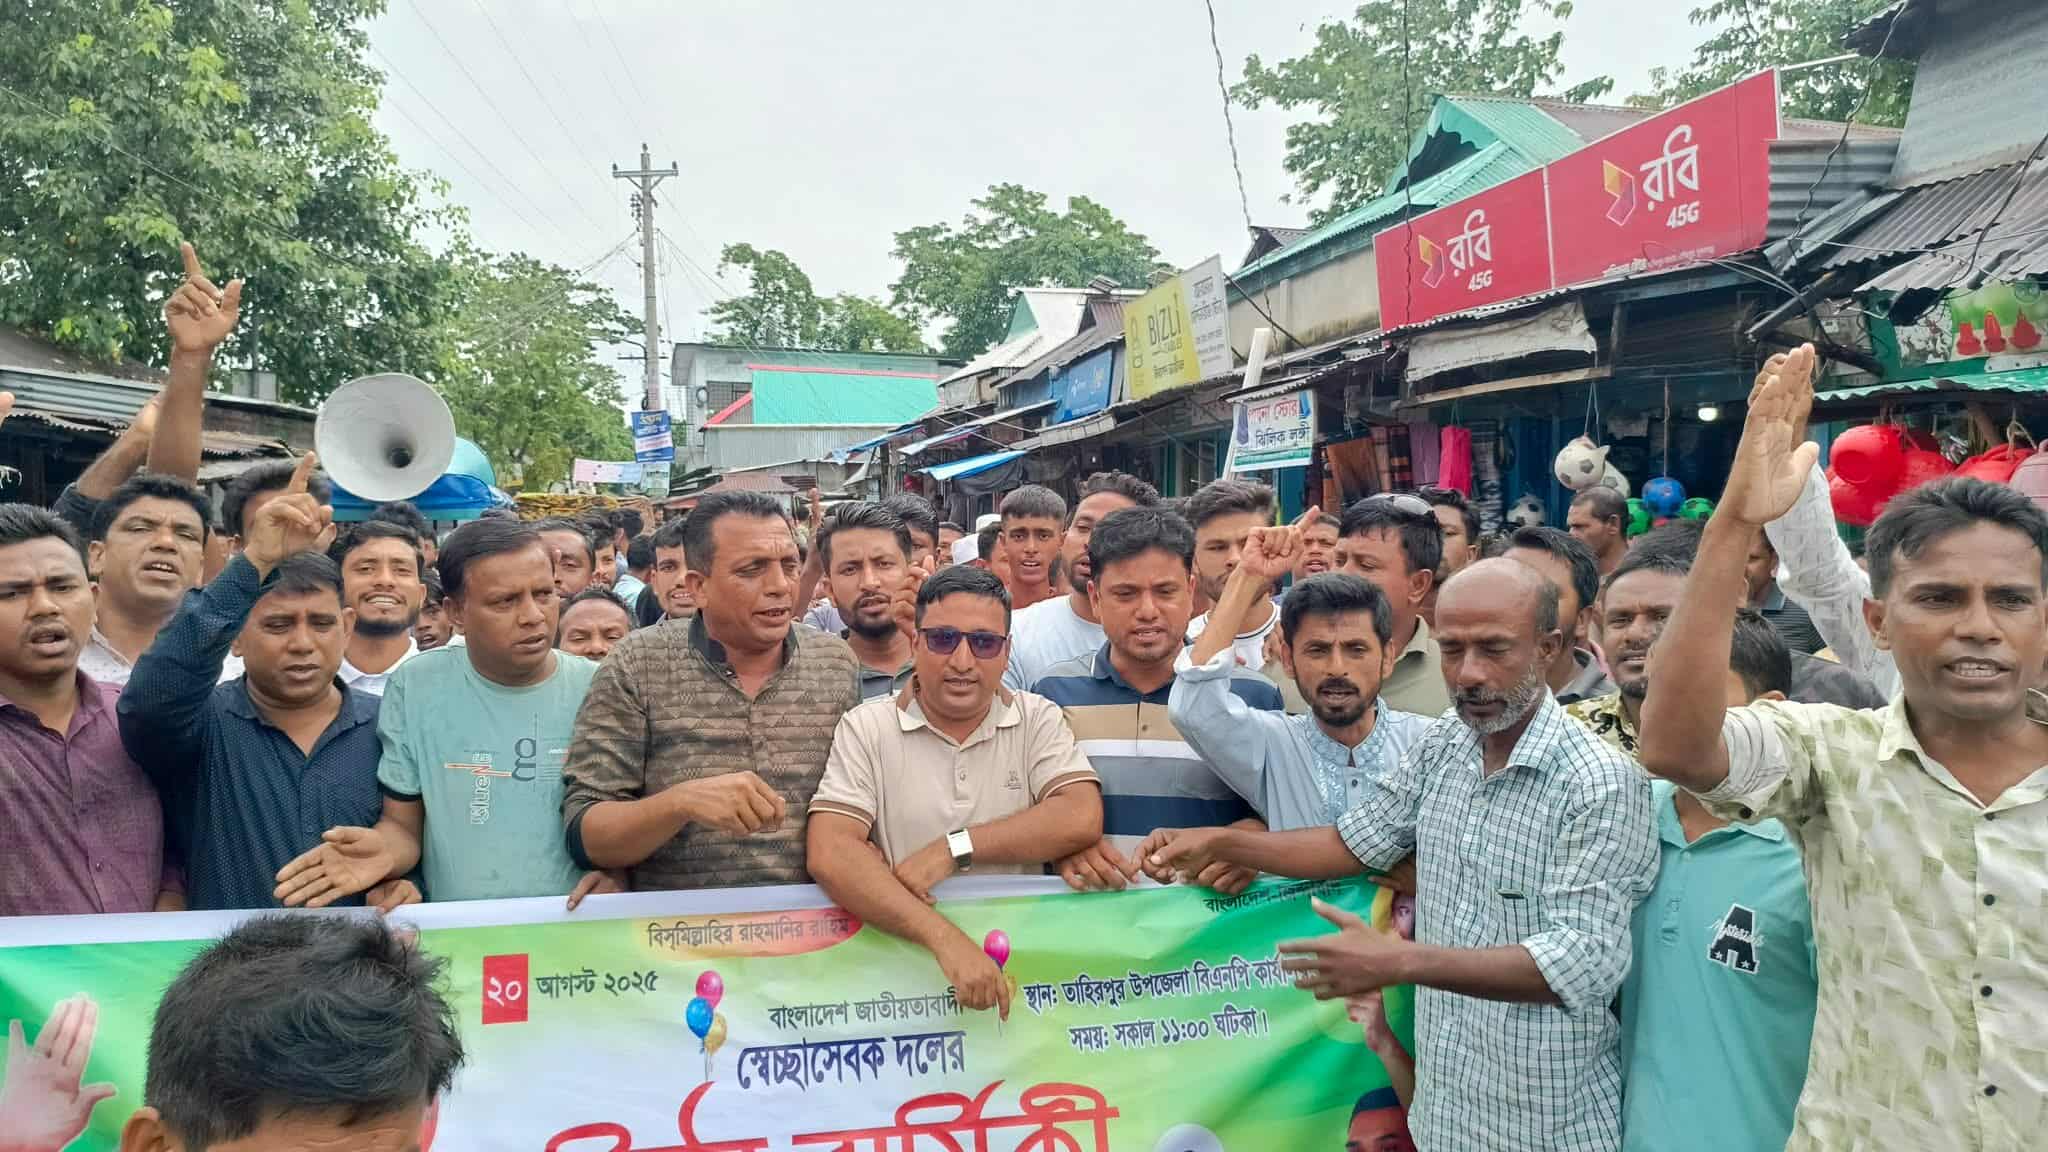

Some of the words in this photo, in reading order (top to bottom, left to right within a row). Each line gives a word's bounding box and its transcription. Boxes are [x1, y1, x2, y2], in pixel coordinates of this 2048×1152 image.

[1639, 124, 1699, 212] রবি
[1446, 208, 1492, 277] রবি
[487, 976, 523, 1007] ২০
[535, 966, 598, 999] আগস্ট
[603, 970, 659, 997] ২০২৫
[1023, 983, 1058, 1015] স্থান:
[1060, 974, 1126, 1008] তাহিরপুর
[1128, 967, 1190, 998] উপজেলা
[1193, 956, 1250, 993] বিএনপি
[768, 1000, 850, 1031] বাংলাদেশ
[1069, 1025, 1110, 1052] সময়:
[1112, 1019, 1156, 1047] সকাল
[1160, 1018, 1210, 1044] ১১:০০
[736, 1037, 888, 1092] স্বেচ্ছাসেবক
[891, 1030, 967, 1078] দলের
